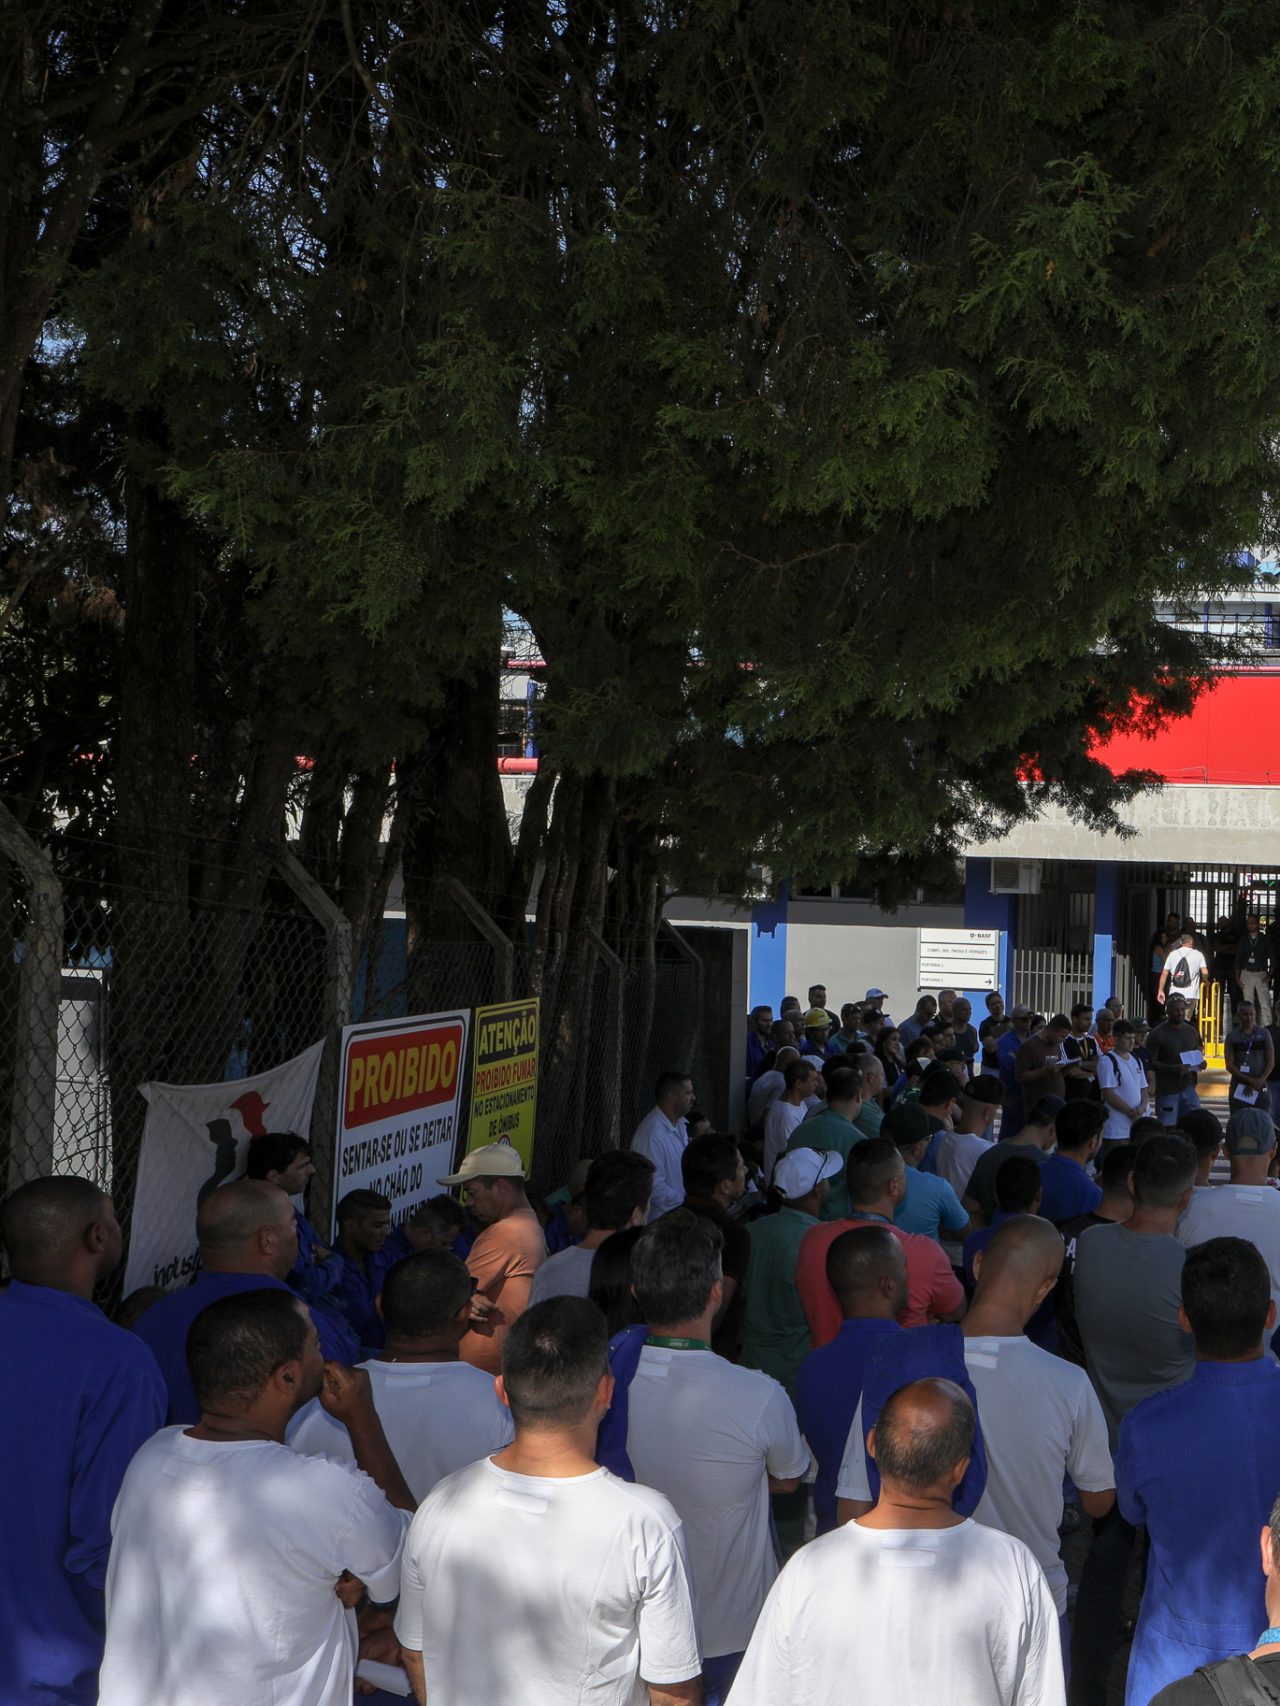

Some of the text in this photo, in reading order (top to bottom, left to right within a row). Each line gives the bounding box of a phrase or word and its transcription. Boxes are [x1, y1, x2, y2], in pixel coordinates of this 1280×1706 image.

[479, 1010, 536, 1055] ATENÇÃO
[348, 1040, 457, 1112] PROIBIDO
[475, 1057, 536, 1095] PROIBIDO FUMAR
[473, 1085, 534, 1119] NO ESTACIONAMENTO
[488, 1112, 520, 1138] DE ÔNIBUS
[342, 1115, 453, 1178] SENTAR-SE OU SE DEITAR
[384, 1163, 408, 1201] CHÃO
[409, 1162, 423, 1193] DO
